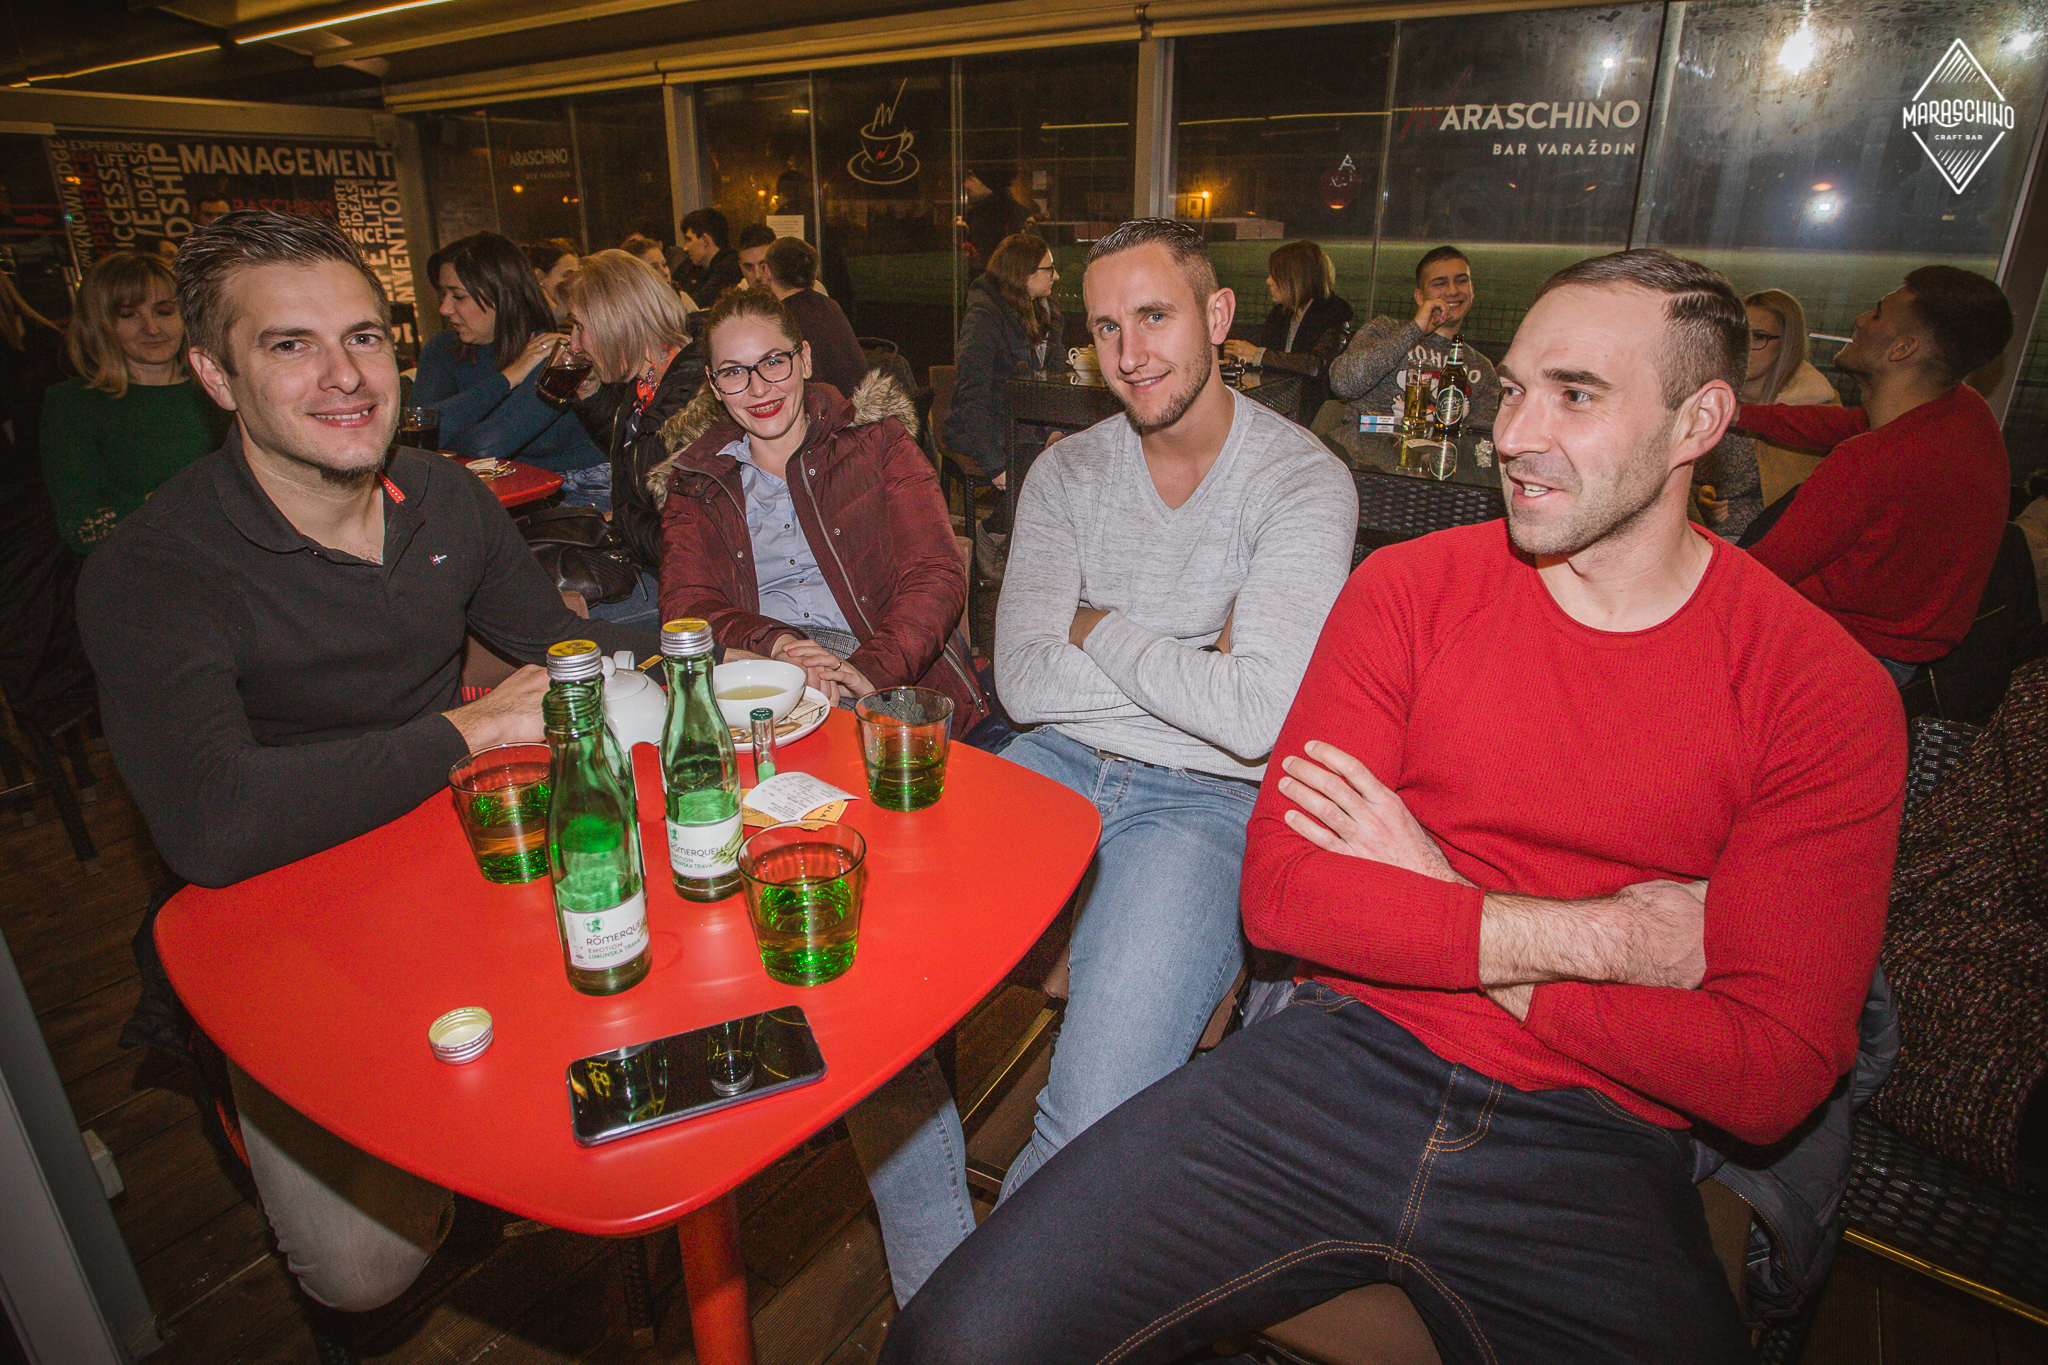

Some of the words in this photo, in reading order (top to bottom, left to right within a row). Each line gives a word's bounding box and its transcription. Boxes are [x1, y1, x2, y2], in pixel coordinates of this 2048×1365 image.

[178, 144, 394, 177] MANAGEMENT
[1493, 143, 1528, 155] BAR
[1537, 139, 1636, 155] VARAŽDIN
[128, 153, 159, 208] IDEAS
[345, 184, 365, 226] IDEAS
[360, 187, 383, 226] LIFE
[377, 181, 416, 302] NVENTION
[588, 942, 623, 954] EMOTION
[588, 948, 623, 960] LIMUNSKA
